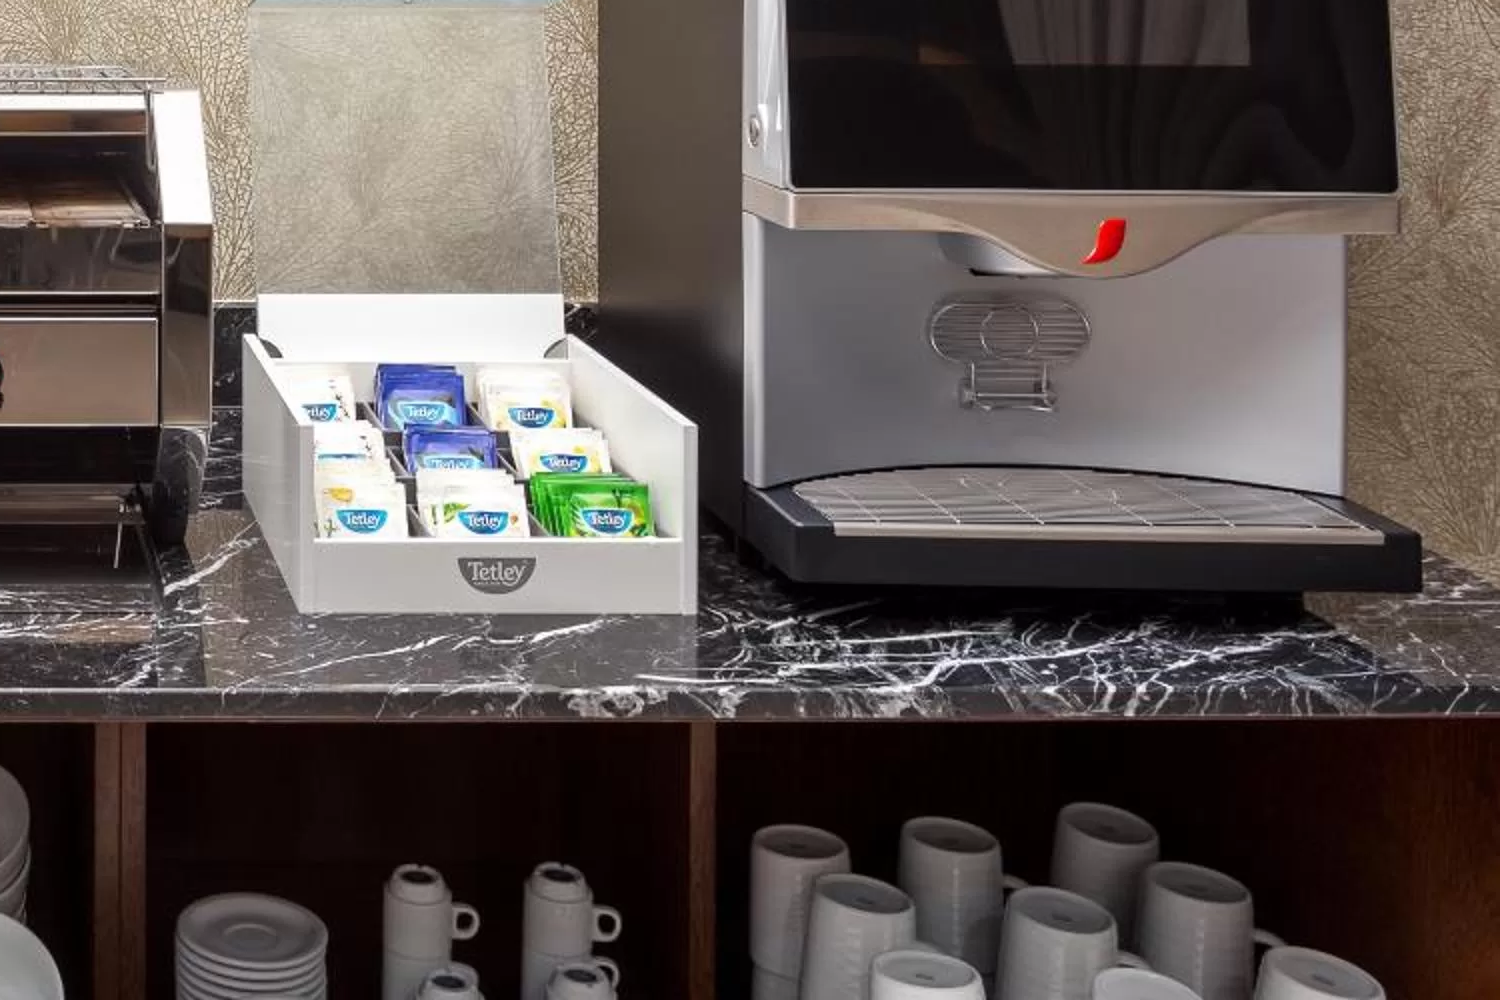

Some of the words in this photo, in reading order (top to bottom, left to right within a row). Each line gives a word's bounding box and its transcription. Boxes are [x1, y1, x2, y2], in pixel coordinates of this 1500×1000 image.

[407, 403, 441, 420] Tetley
[515, 407, 549, 424] Tetley
[547, 455, 583, 471] Tetley
[344, 510, 381, 528] Tetley
[466, 511, 505, 529] Tetley
[589, 510, 628, 528] Tetley
[467, 561, 526, 587] Tetley
